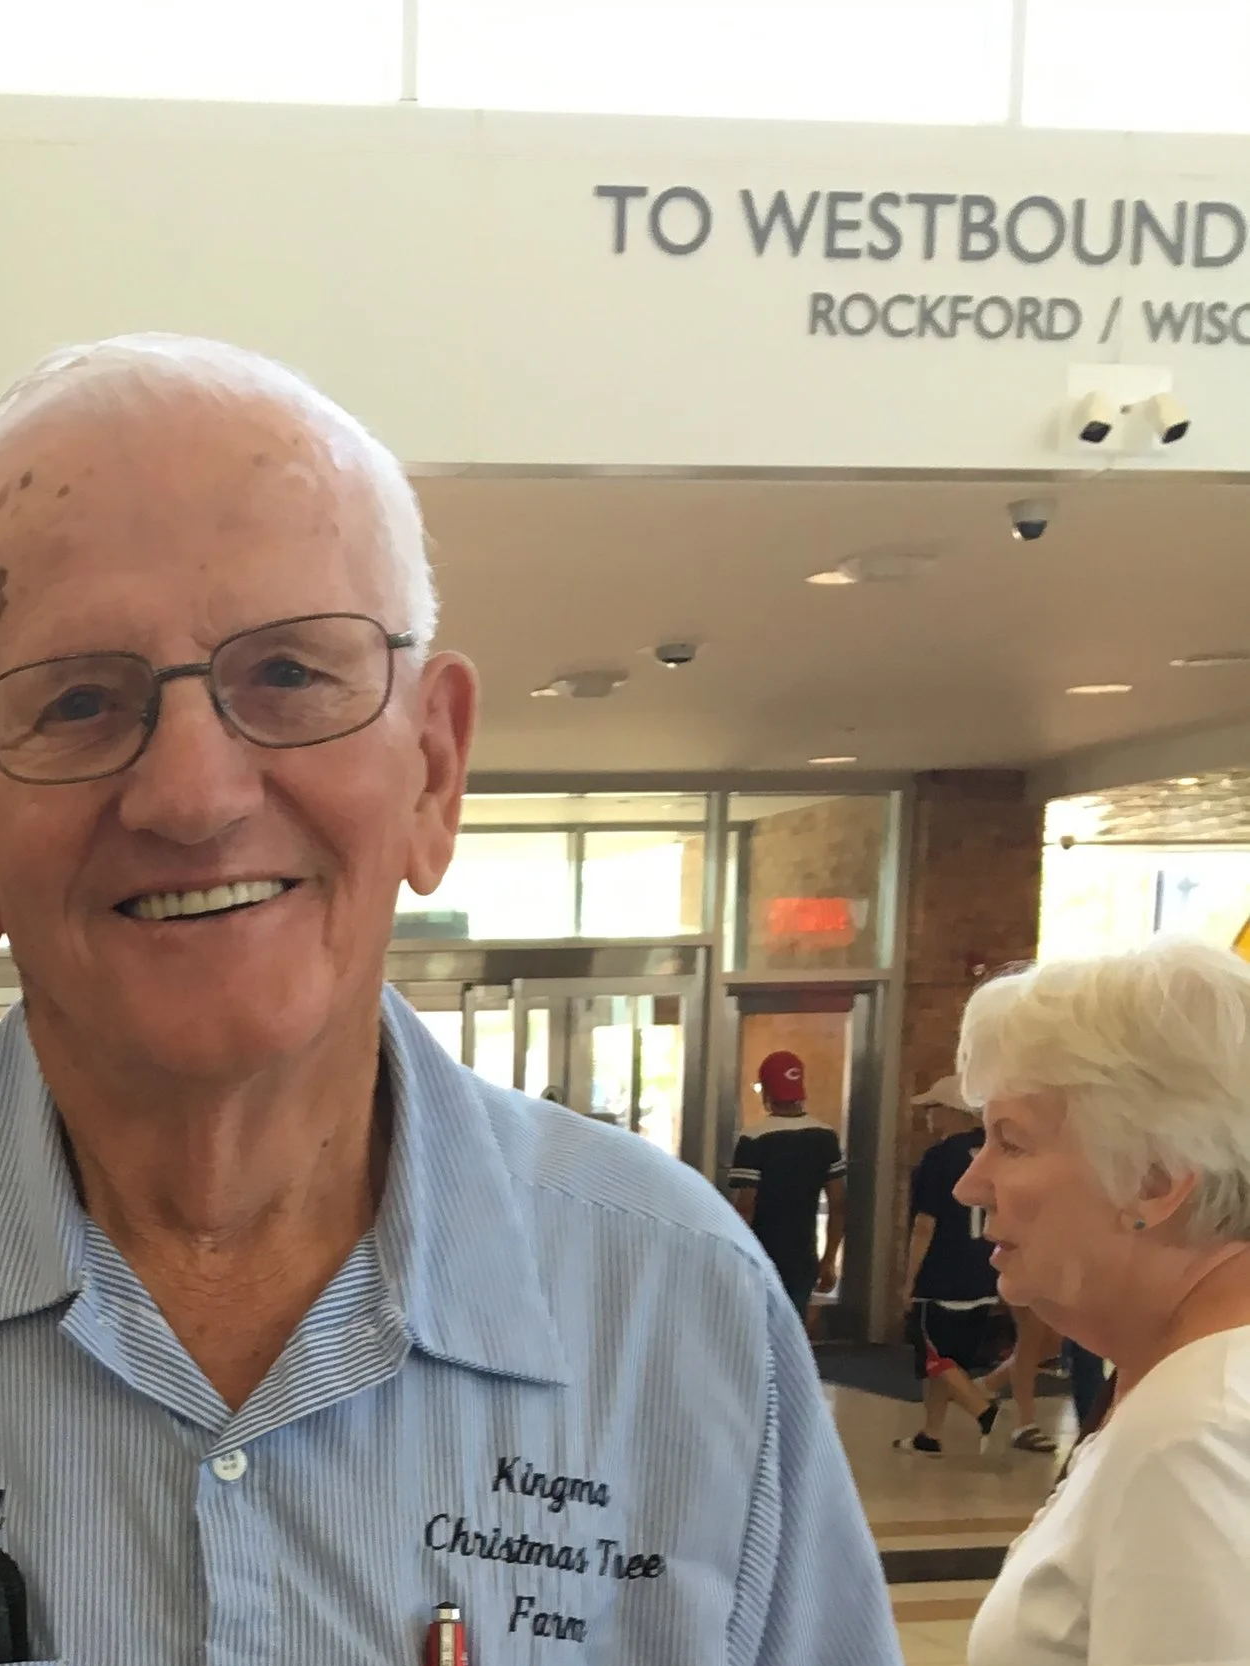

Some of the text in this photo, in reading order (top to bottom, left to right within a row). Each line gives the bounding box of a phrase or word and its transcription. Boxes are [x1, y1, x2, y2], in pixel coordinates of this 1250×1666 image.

[593, 184, 1248, 269] TO WESTBOUND
[807, 292, 1083, 342] ROCKFORD
[425, 1513, 666, 1580] Christmas Tree
[508, 1596, 587, 1643] Farm
